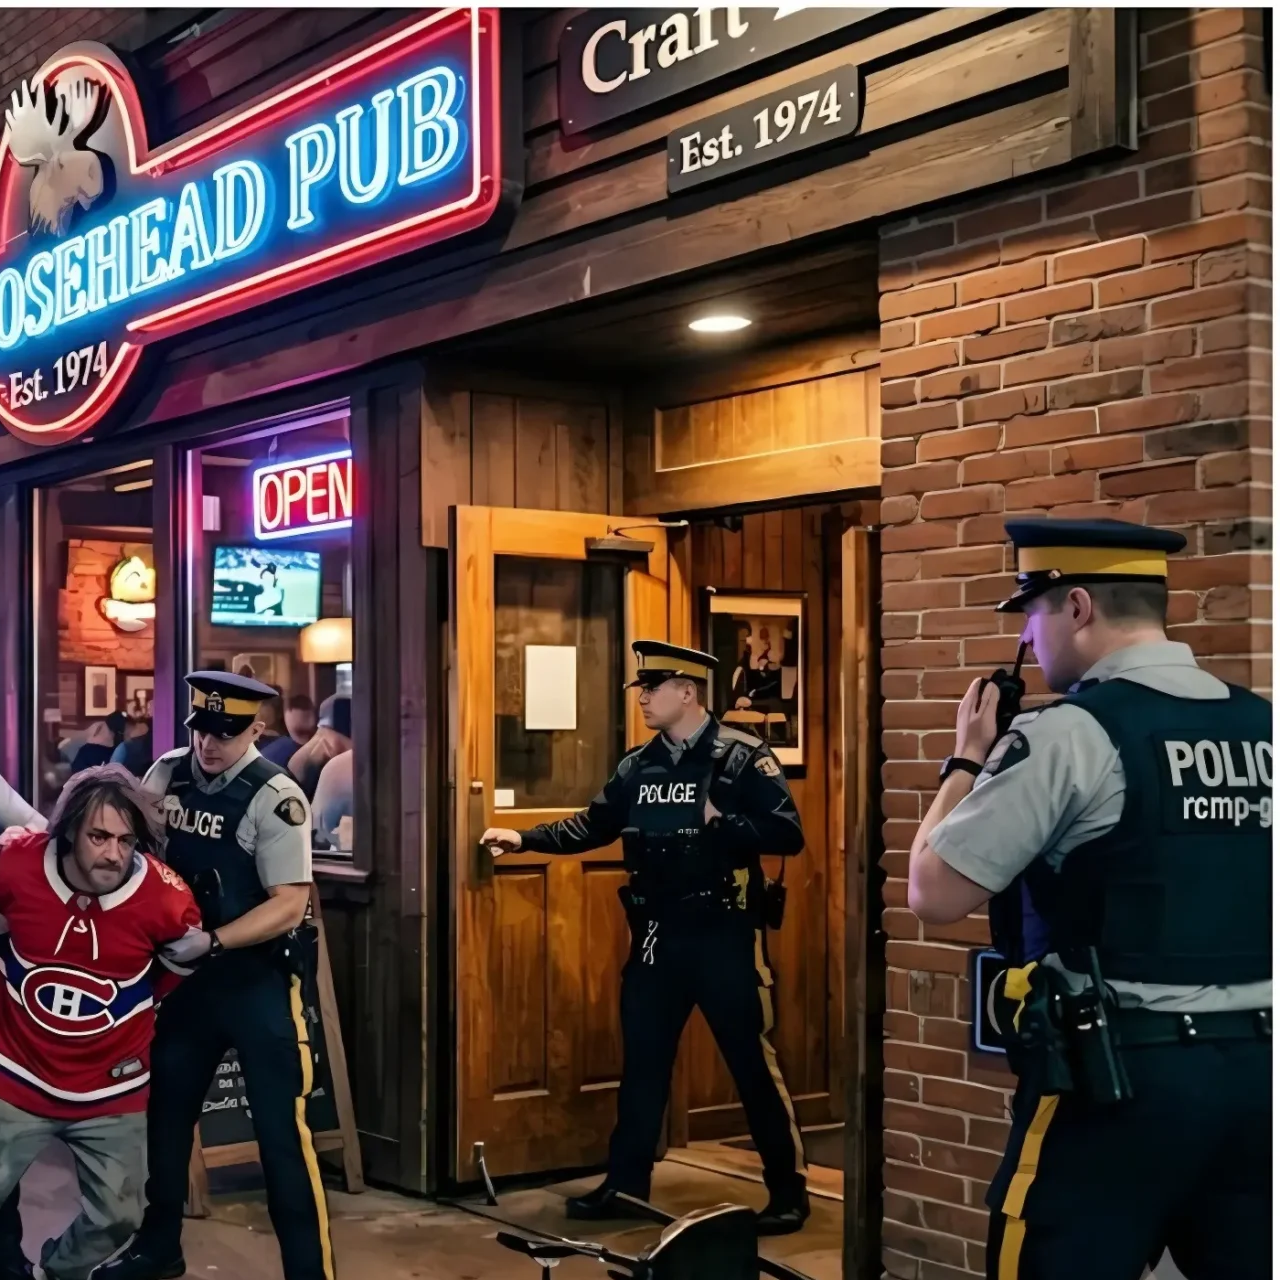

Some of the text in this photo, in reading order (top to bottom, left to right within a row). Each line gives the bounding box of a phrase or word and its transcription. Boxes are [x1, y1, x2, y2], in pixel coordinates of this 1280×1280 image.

[284, 65, 461, 232] PUB
[679, 82, 842, 175] Est. 1974
[9, 340, 108, 411] Est. 1974
[260, 458, 353, 530] OPEN
